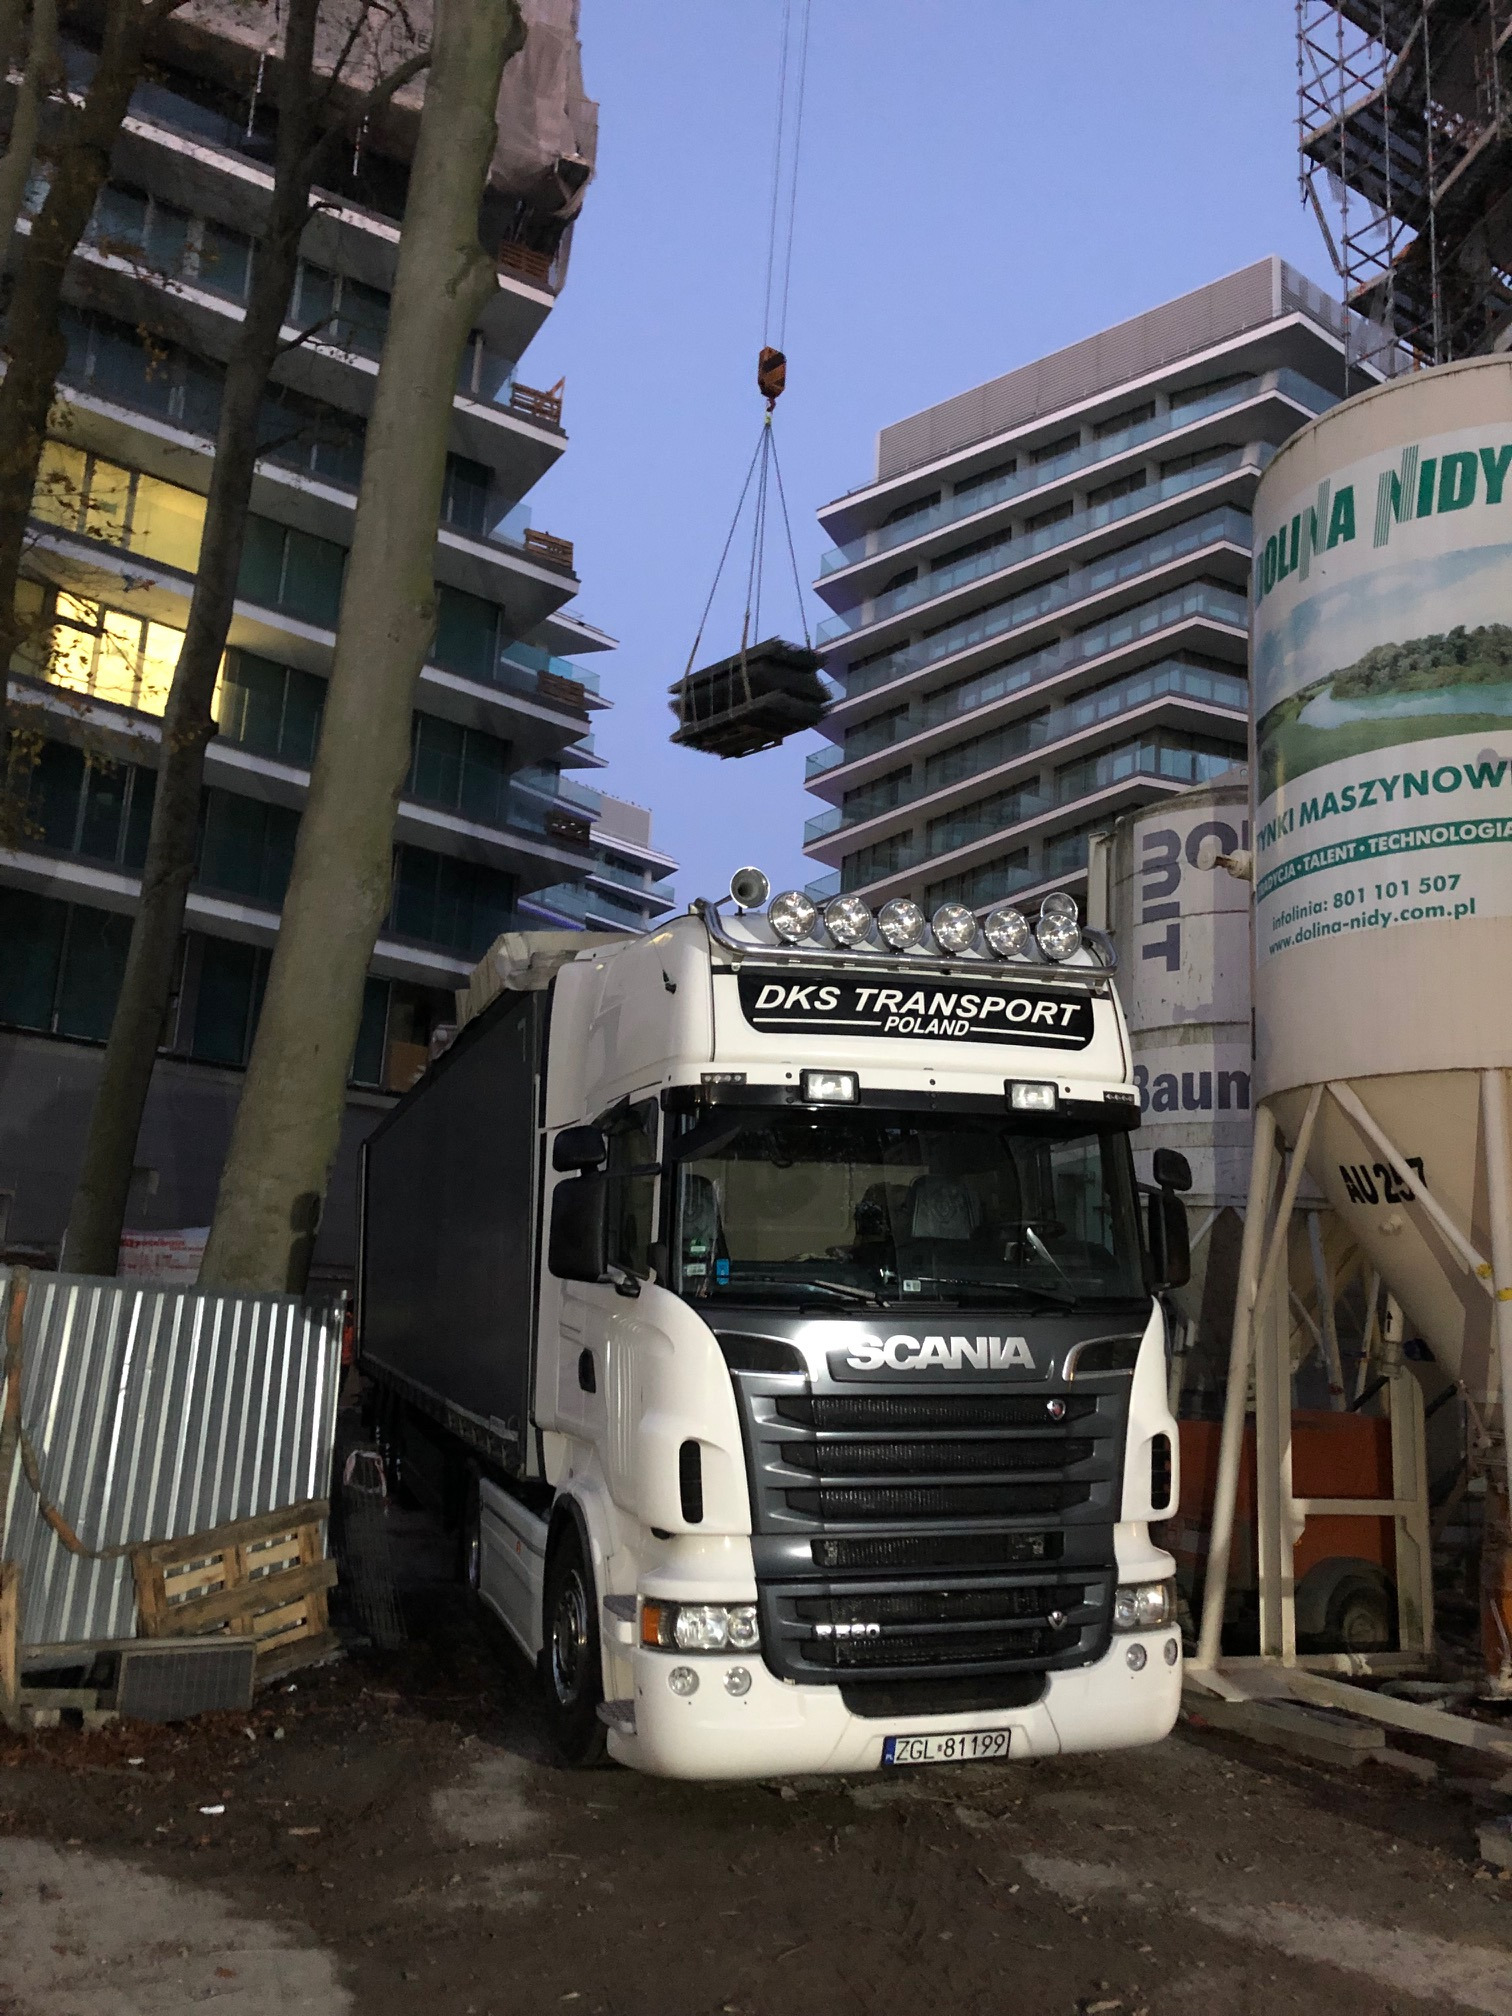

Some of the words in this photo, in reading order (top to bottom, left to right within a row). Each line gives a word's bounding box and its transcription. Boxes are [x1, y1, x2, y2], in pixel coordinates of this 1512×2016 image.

[1373, 444, 1512, 549] NIDY
[1300, 761, 1512, 827] MASZYNOW
[1303, 843, 1356, 871] TALENT
[1269, 898, 1476, 955] www.dolina-nidy.com.pl
[1273, 899, 1328, 931] infolinia:
[1334, 888, 1365, 909] 801
[1375, 879, 1410, 900] 101
[1419, 874, 1461, 895] 507
[755, 984, 841, 1011] DKS
[854, 987, 1081, 1027] TRANSPORT
[884, 1016, 970, 1036] POLAND
[846, 1334, 1036, 1370] SCANIA
